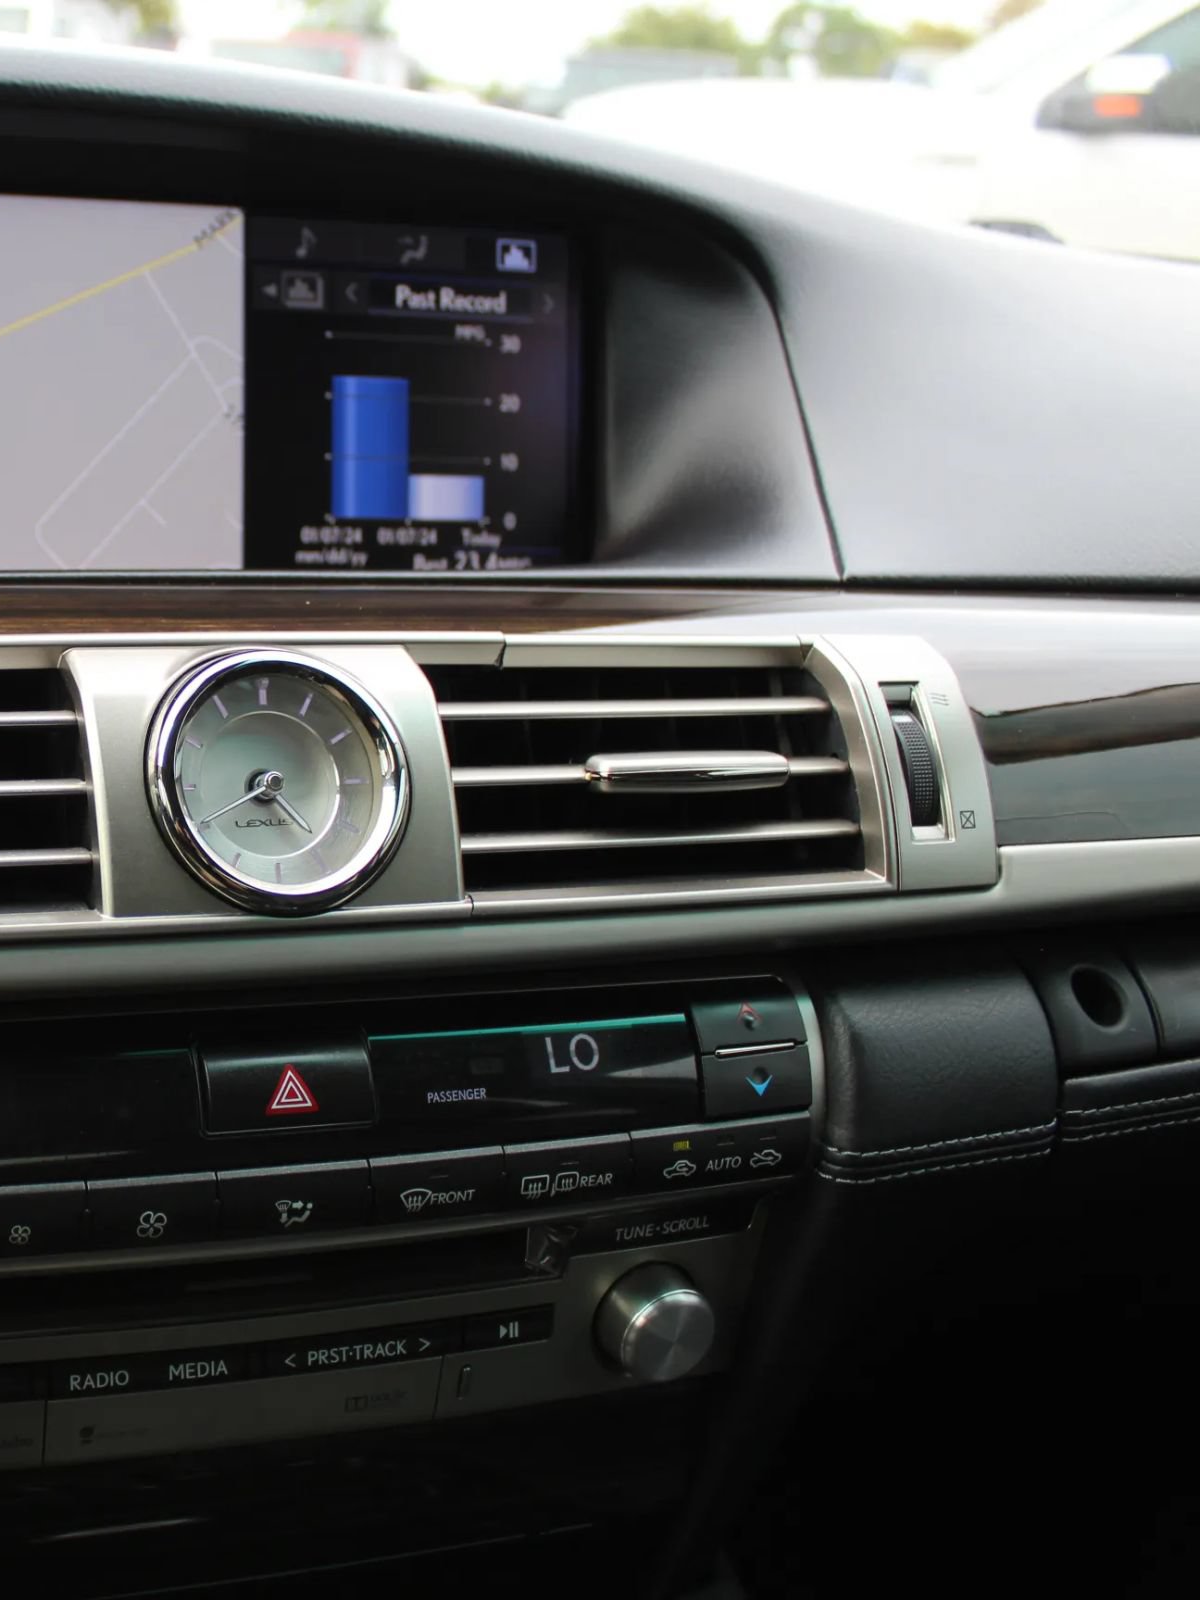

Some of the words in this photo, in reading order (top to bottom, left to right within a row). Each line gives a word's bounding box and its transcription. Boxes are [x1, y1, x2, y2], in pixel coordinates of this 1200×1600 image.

[395, 284, 435, 310] Past
[440, 287, 507, 314] Record
[504, 512, 517, 530] 0
[544, 1033, 600, 1074] LO
[427, 1087, 487, 1104] PASSENGER
[704, 1155, 742, 1172] AUTO
[579, 1172, 613, 1188] REAR
[430, 1189, 476, 1206] FRONT
[168, 1359, 229, 1382] MEDIA
[69, 1370, 130, 1392] RADIO
